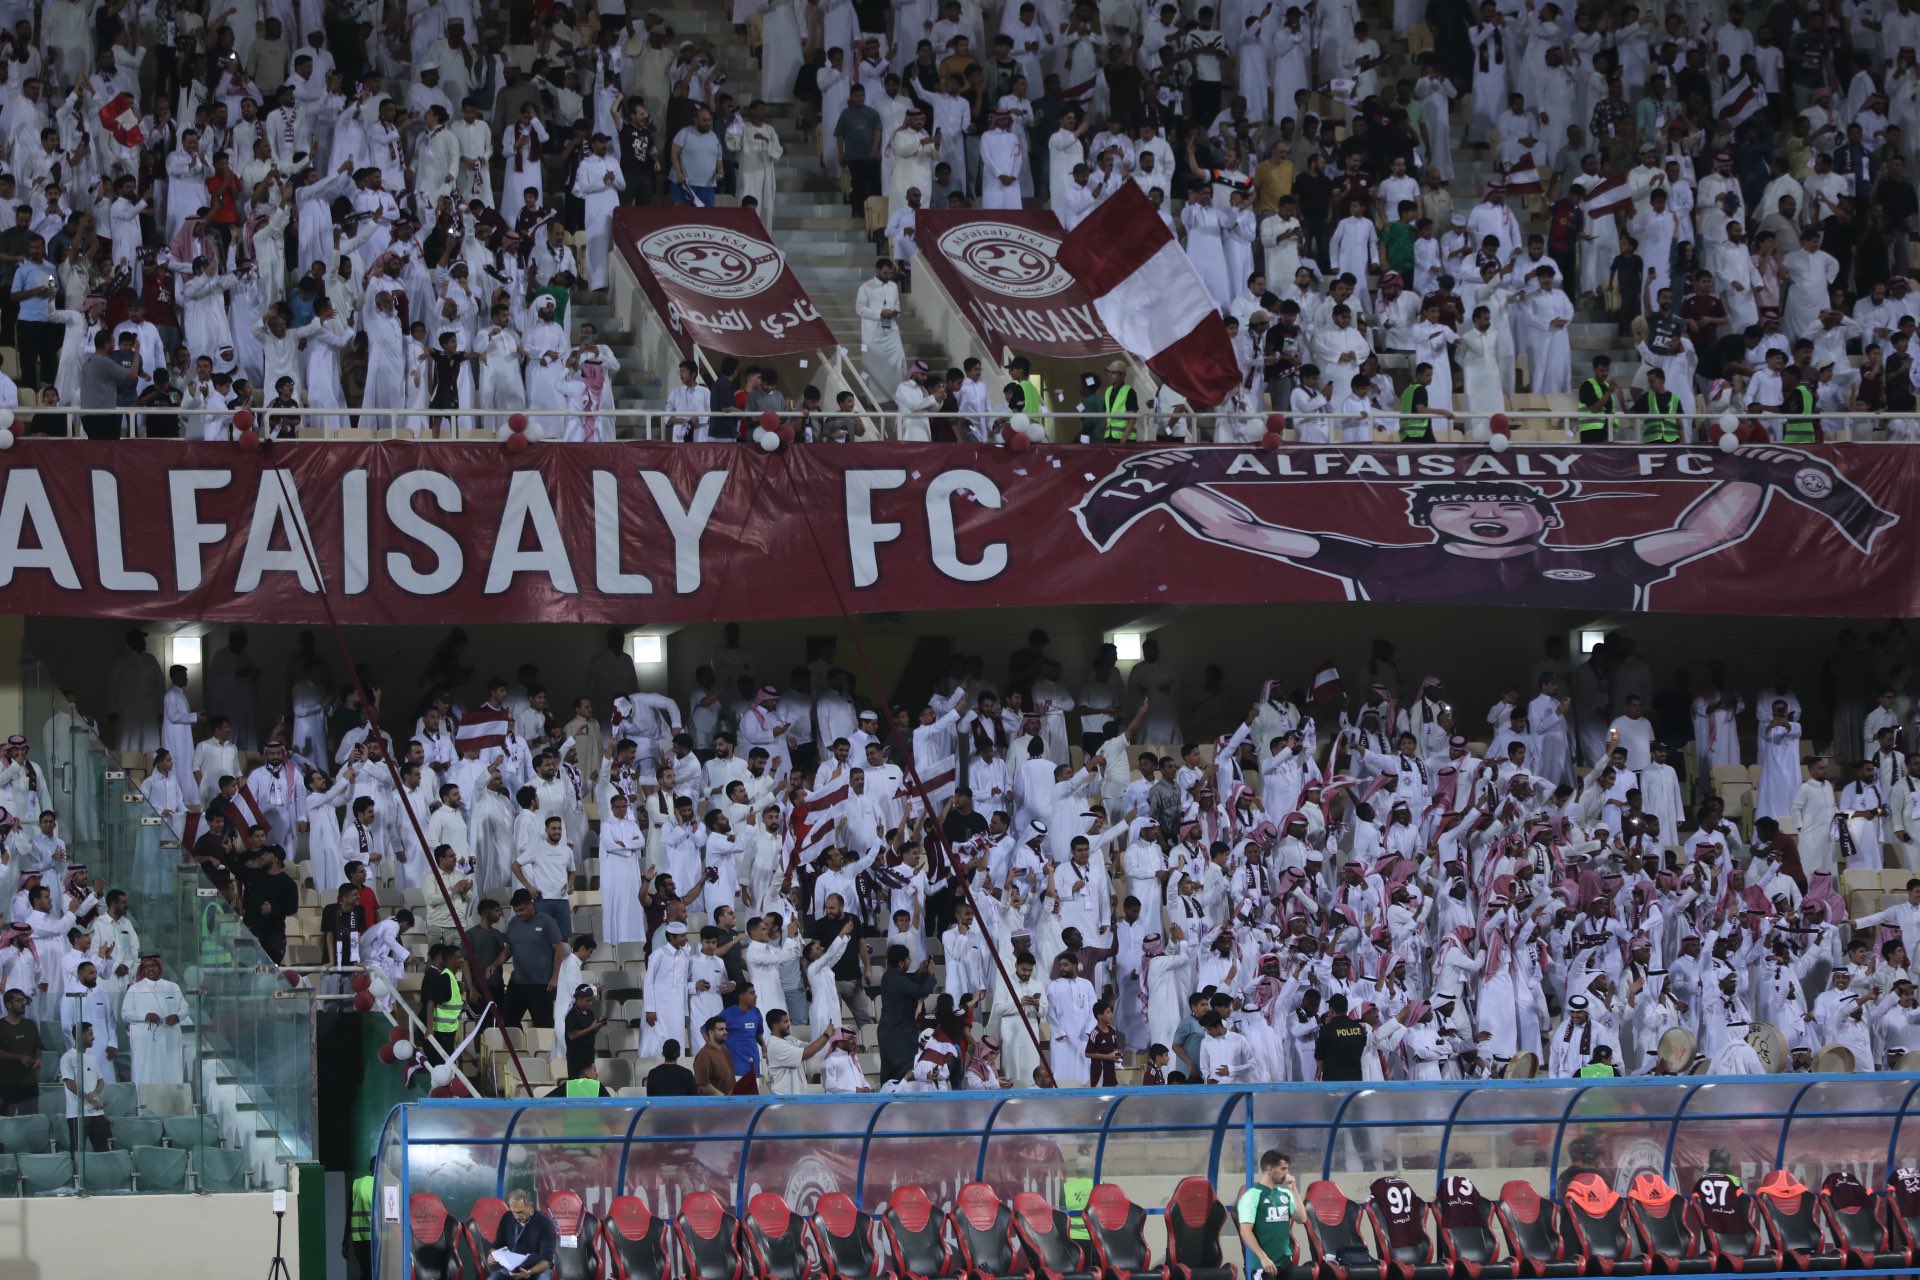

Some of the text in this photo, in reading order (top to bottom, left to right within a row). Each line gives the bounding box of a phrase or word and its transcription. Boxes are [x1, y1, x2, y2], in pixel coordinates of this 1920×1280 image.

[721, 236, 749, 250] KSA
[1017, 234, 1044, 248] KSA
[760, 298, 822, 339] نادي
[969, 297, 1102, 343] ALFAISALY
[1225, 453, 1715, 477] ALFAISALY FC
[1100, 477, 1169, 501] 12
[0, 468, 1008, 595] ALFAISALY FC
[1336, 1027, 1362, 1037] POLICE
[1387, 1186, 1412, 1214] 91
[1700, 1179, 1730, 1206] 97
